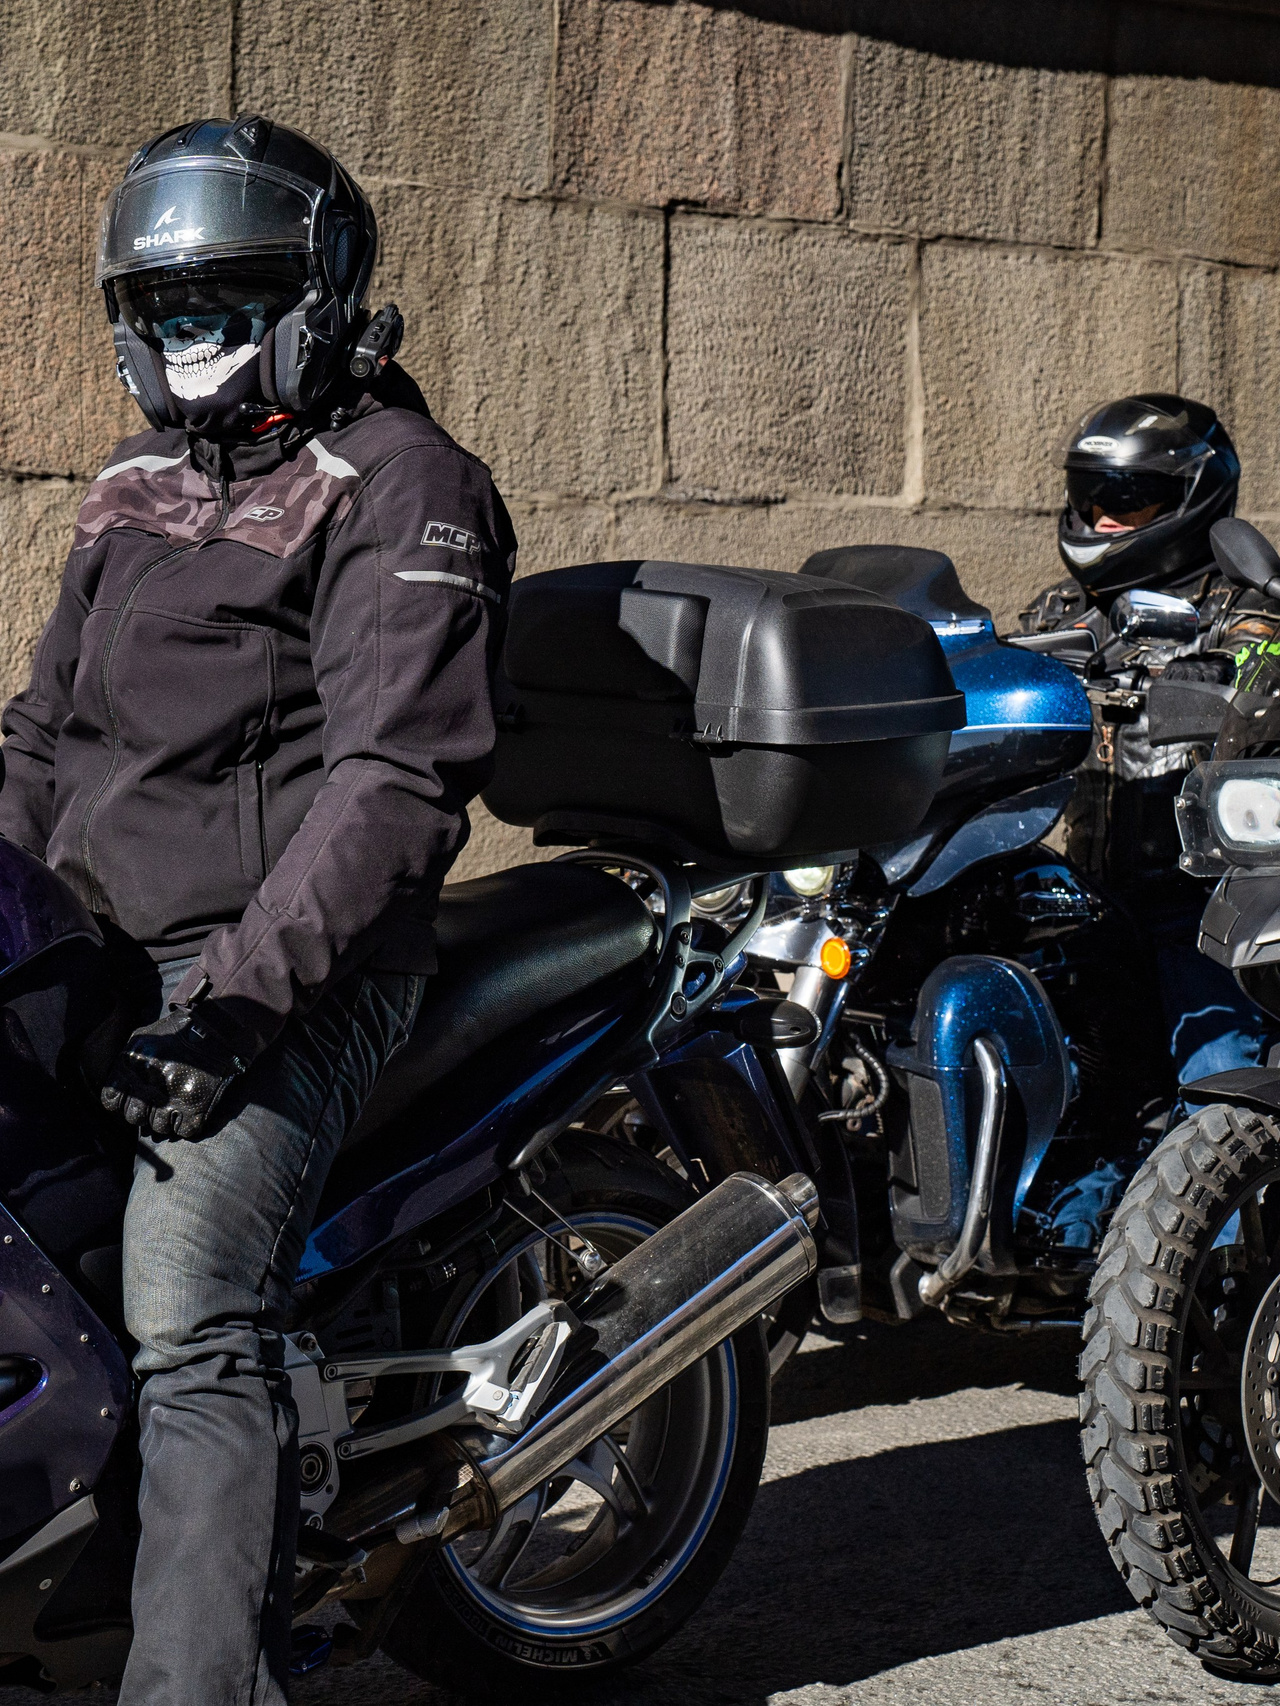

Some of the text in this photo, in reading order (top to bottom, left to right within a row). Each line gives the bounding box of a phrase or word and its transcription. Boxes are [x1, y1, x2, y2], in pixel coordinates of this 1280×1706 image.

[133, 227, 205, 250] SHARK
[246, 507, 284, 521] CP
[421, 522, 480, 554] MCP
[495, 1636, 578, 1663] MICHELIN
